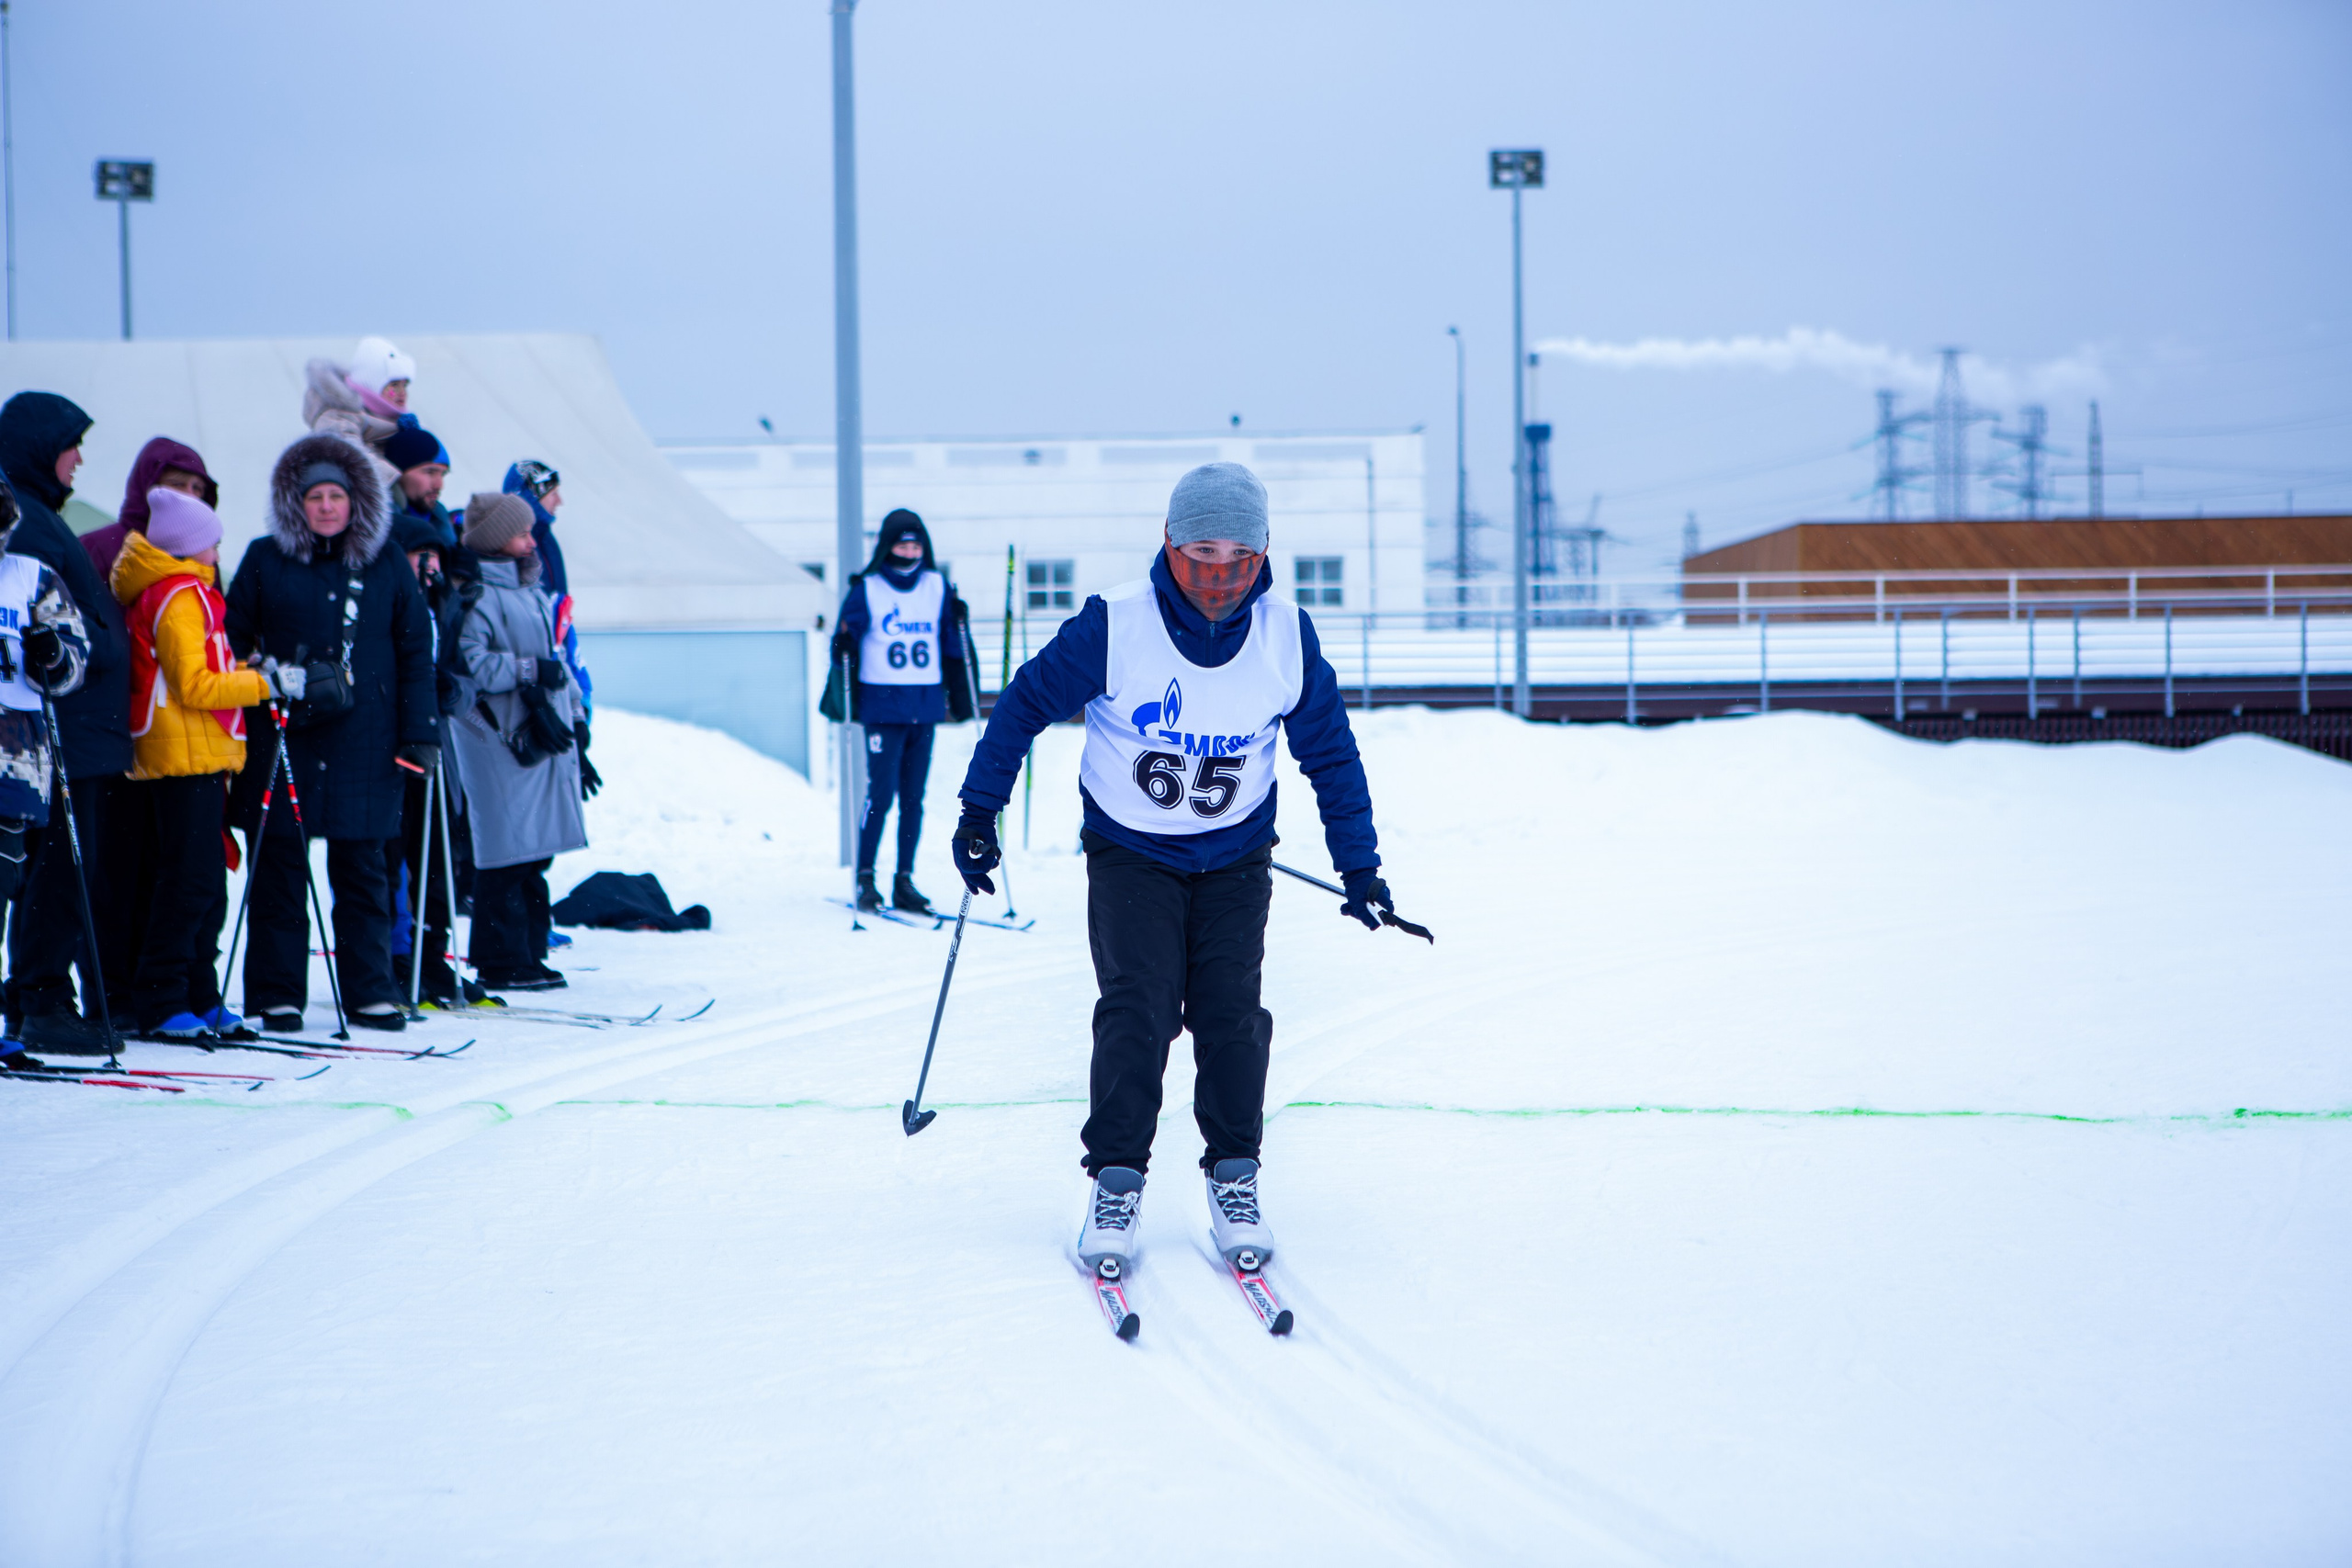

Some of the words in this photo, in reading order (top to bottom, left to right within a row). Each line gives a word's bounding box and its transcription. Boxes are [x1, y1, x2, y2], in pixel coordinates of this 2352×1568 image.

[888, 640, 930, 670] 66
[1133, 750, 1247, 818] 65
[1100, 1288, 1126, 1325] MADSH
[1242, 1282, 1278, 1325] MADSHU
